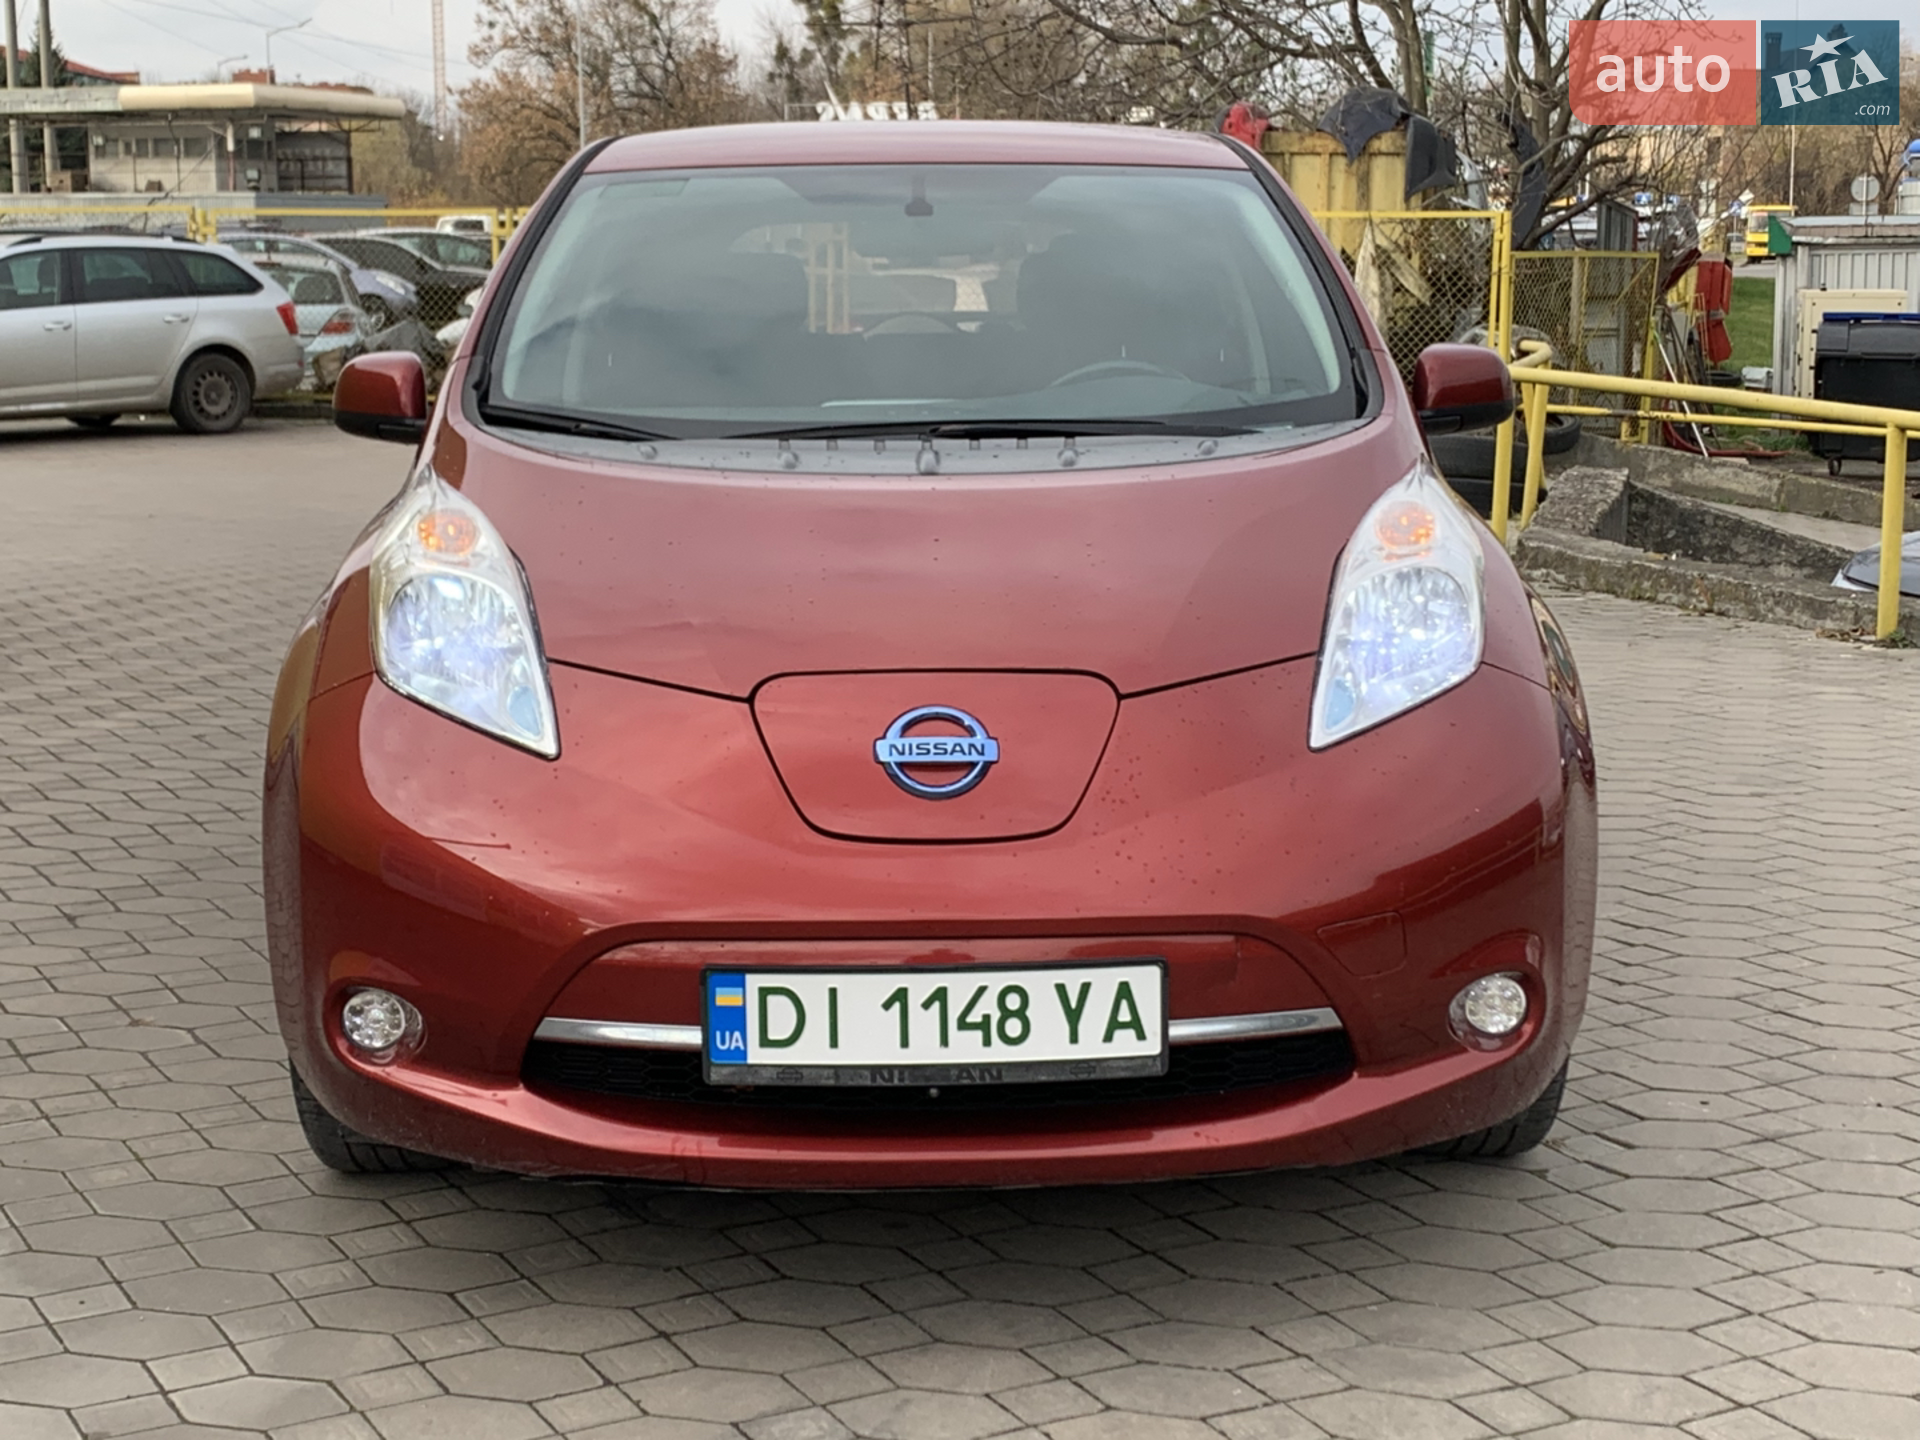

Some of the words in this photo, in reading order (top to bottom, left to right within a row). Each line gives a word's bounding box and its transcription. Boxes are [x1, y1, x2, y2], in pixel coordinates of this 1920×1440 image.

[889, 742, 985, 757] NISSAN
[757, 985, 839, 1049] DI
[881, 983, 1031, 1049] 1148
[1054, 980, 1148, 1045] YA
[715, 1030, 745, 1050] UA
[869, 1066, 1003, 1085] NIAN
